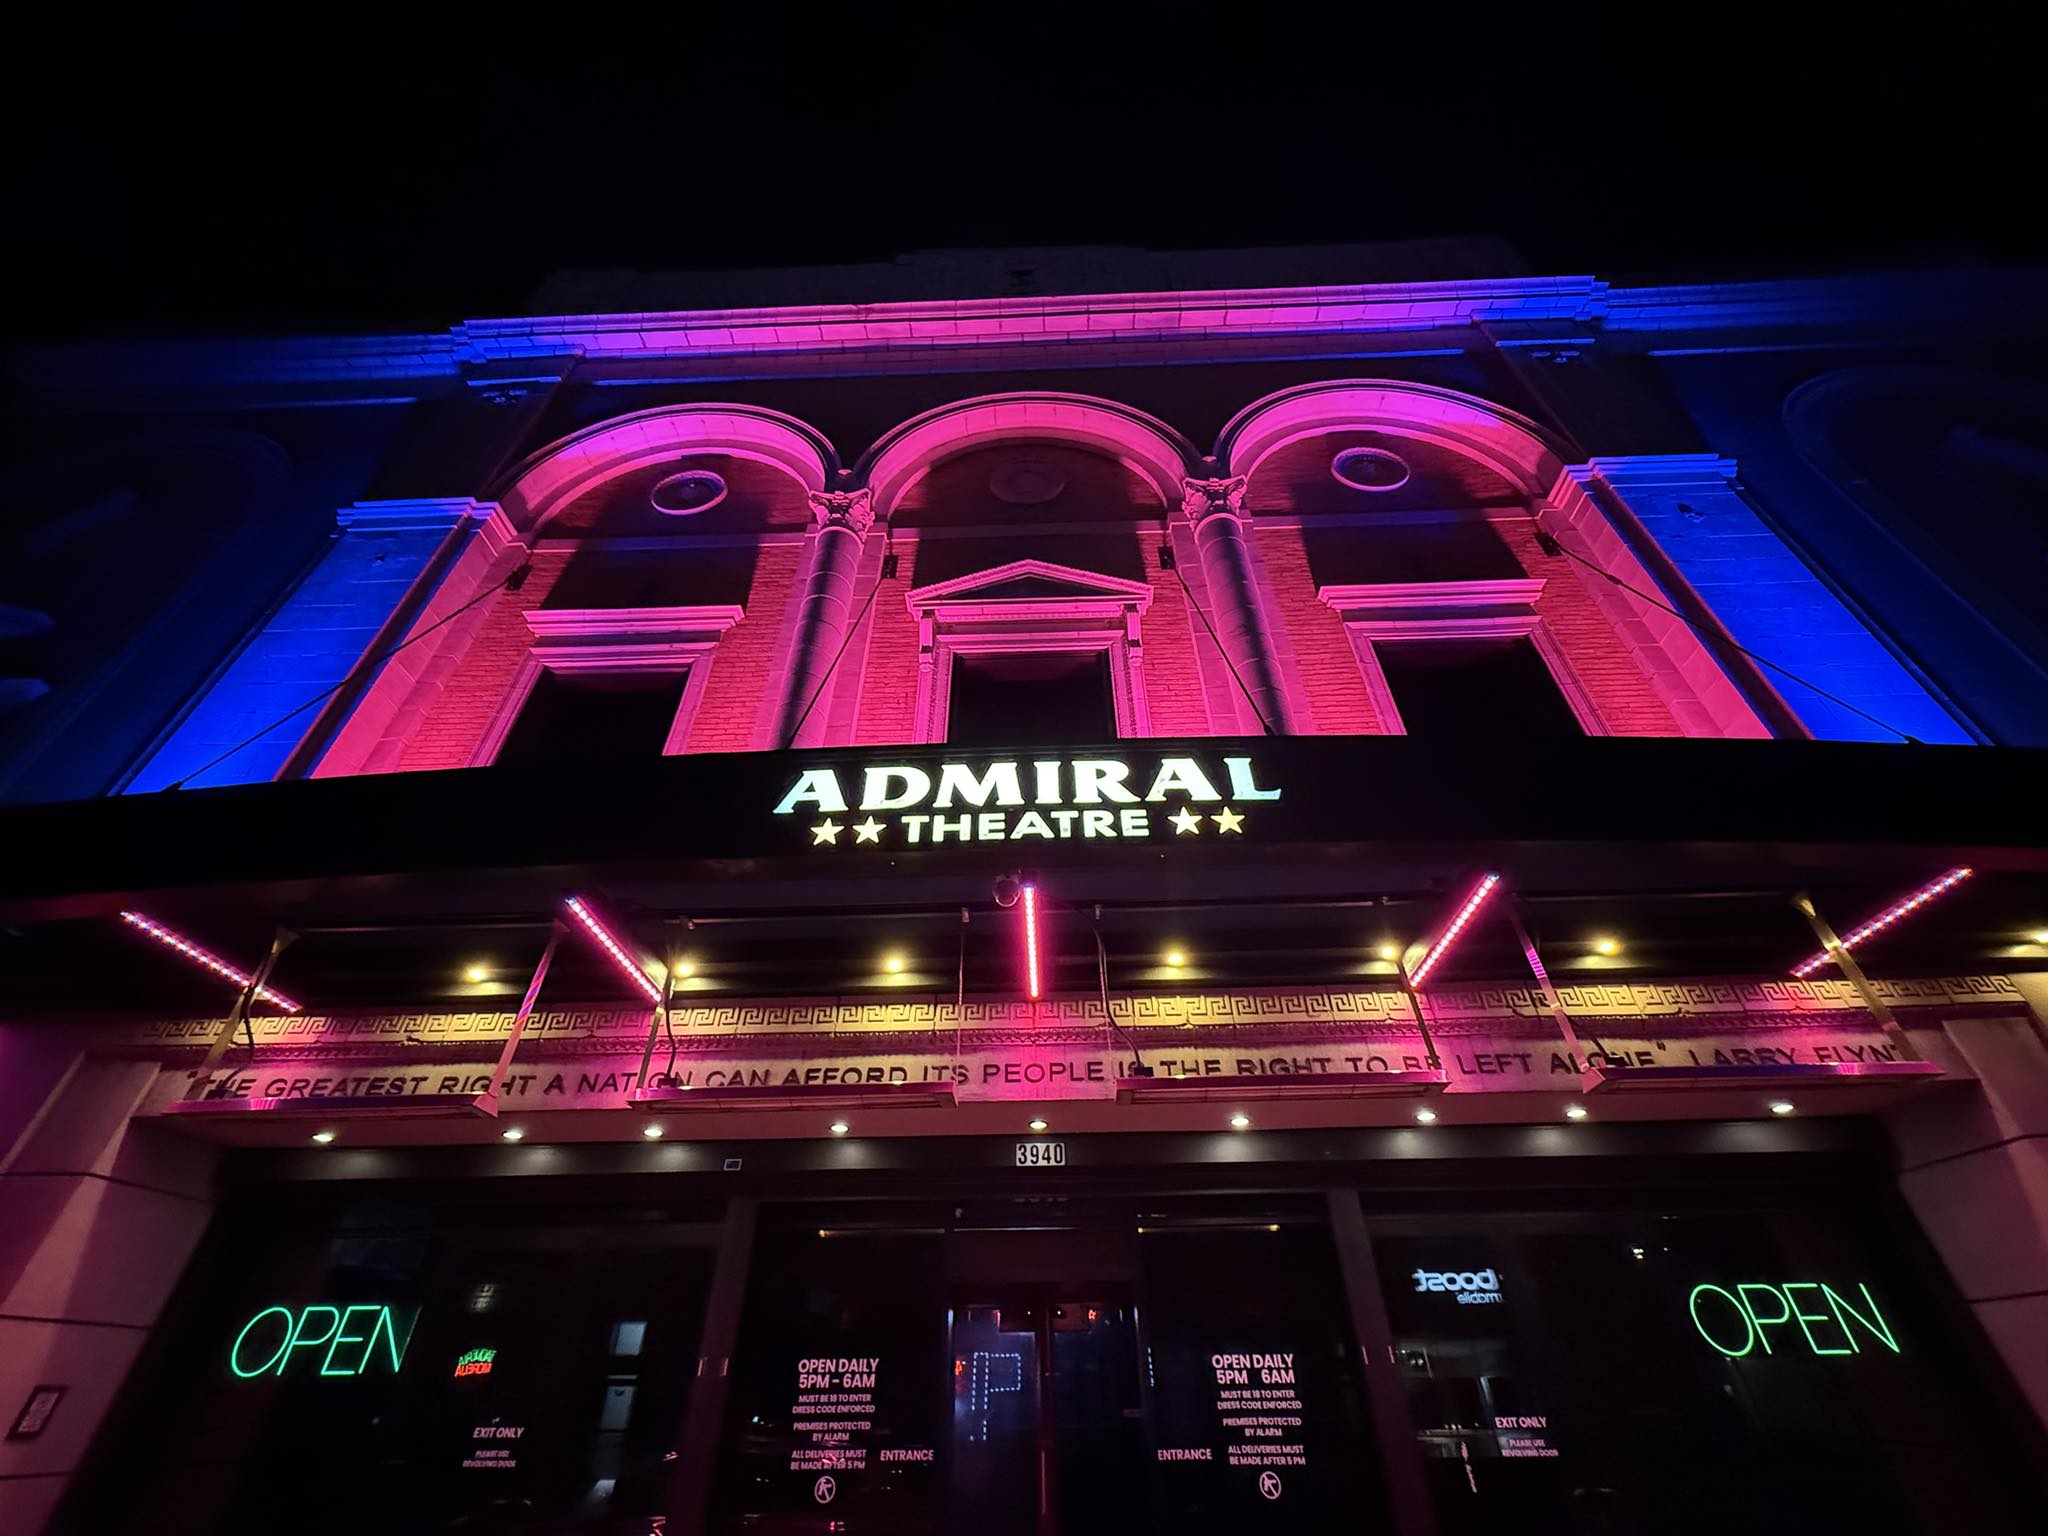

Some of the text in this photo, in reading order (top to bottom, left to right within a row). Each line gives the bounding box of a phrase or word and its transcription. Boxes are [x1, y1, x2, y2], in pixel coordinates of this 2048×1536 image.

[773, 757, 1282, 814] ADMIRAL
[902, 809, 1150, 843] THEATRE
[264, 1076, 428, 1098] GREATEST
[437, 1074, 537, 1096] RIGHT
[543, 1073, 565, 1096] A
[577, 1071, 692, 1093] NATON
[705, 1069, 770, 1087] CAN
[782, 1066, 908, 1086] AFFORD
[923, 1064, 970, 1085] ITS
[982, 1061, 1105, 1083] PEOPLE
[1160, 1060, 1221, 1076] THE
[1236, 1057, 1331, 1075] RIGHT
[1345, 1056, 1388, 1072] TO
[1456, 1053, 1532, 1074] LEFT
[1688, 1047, 1795, 1066] LARRY
[1813, 1044, 1898, 1064] FLYN
[1018, 1143, 1063, 1165] 3940
[1689, 1282, 1901, 1357] OPEN
[231, 1305, 421, 1378] OPEN
[798, 1358, 879, 1373] OPEN DAILY
[1212, 1354, 1294, 1368] OPEN DAILY
[799, 1374, 830, 1388] 5PM
[843, 1374, 876, 1388] 6AM
[1216, 1369, 1295, 1384] 5PM 6AM
[798, 1395, 820, 1403] MUST
[839, 1394, 848, 1402] TO
[849, 1394, 872, 1402] ENTER
[1221, 1390, 1241, 1398] MUST
[1242, 1390, 1251, 1398] BE
[1261, 1390, 1271, 1398] TO
[1272, 1390, 1295, 1398] ENTER
[816, 1405, 836, 1414] CODE
[837, 1405, 876, 1413] ENFORCED
[1242, 1401, 1262, 1409] CODE
[1263, 1401, 1302, 1409] ENFORCED
[793, 1421, 871, 1430] PREMISES PROTECTED
[1223, 1417, 1302, 1426] PREMISES PROTECTED
[1495, 1416, 1547, 1428] EXIT ONLY
[473, 1427, 525, 1438] EXIT ONLY
[812, 1432, 850, 1441] BY ALARM
[1244, 1428, 1282, 1437] BY ALARM
[791, 1450, 804, 1458] ALL
[845, 1449, 867, 1458] MUST
[1158, 1449, 1213, 1460] ENTRANCE
[1228, 1445, 1304, 1454] ALL DELIVERIES MUST
[880, 1450, 934, 1461] ENTRANCE
[1229, 1456, 1239, 1465] BE
[1240, 1456, 1262, 1465] MADE
[1263, 1456, 1287, 1465] AFTER
[1293, 1456, 1306, 1465] PM
[790, 1461, 800, 1470] BE
[800, 1461, 822, 1470] MADE
[853, 1461, 865, 1469] PM
